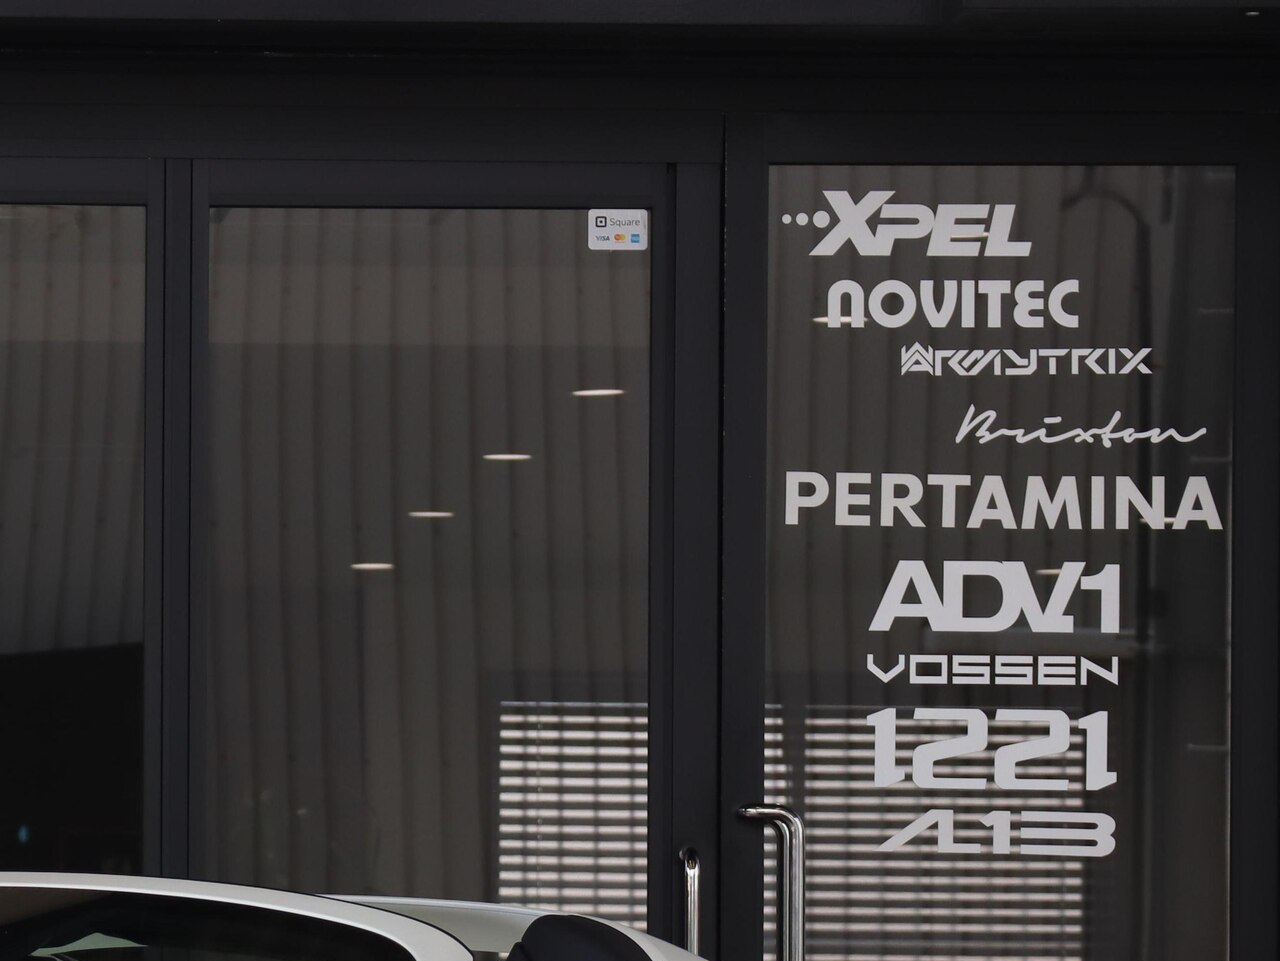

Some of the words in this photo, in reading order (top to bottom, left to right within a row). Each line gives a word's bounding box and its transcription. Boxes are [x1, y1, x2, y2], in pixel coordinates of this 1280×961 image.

[609, 218, 640, 227] Square
[808, 190, 1032, 257] XPEL
[827, 279, 1080, 328] NOVITEC
[901, 341, 1153, 376] ARMYTRIX
[955, 404, 1207, 448] Brixton
[785, 471, 1224, 530] PERTAMINA
[867, 654, 1119, 686] VOSSEN
[866, 707, 1118, 791] 1221
